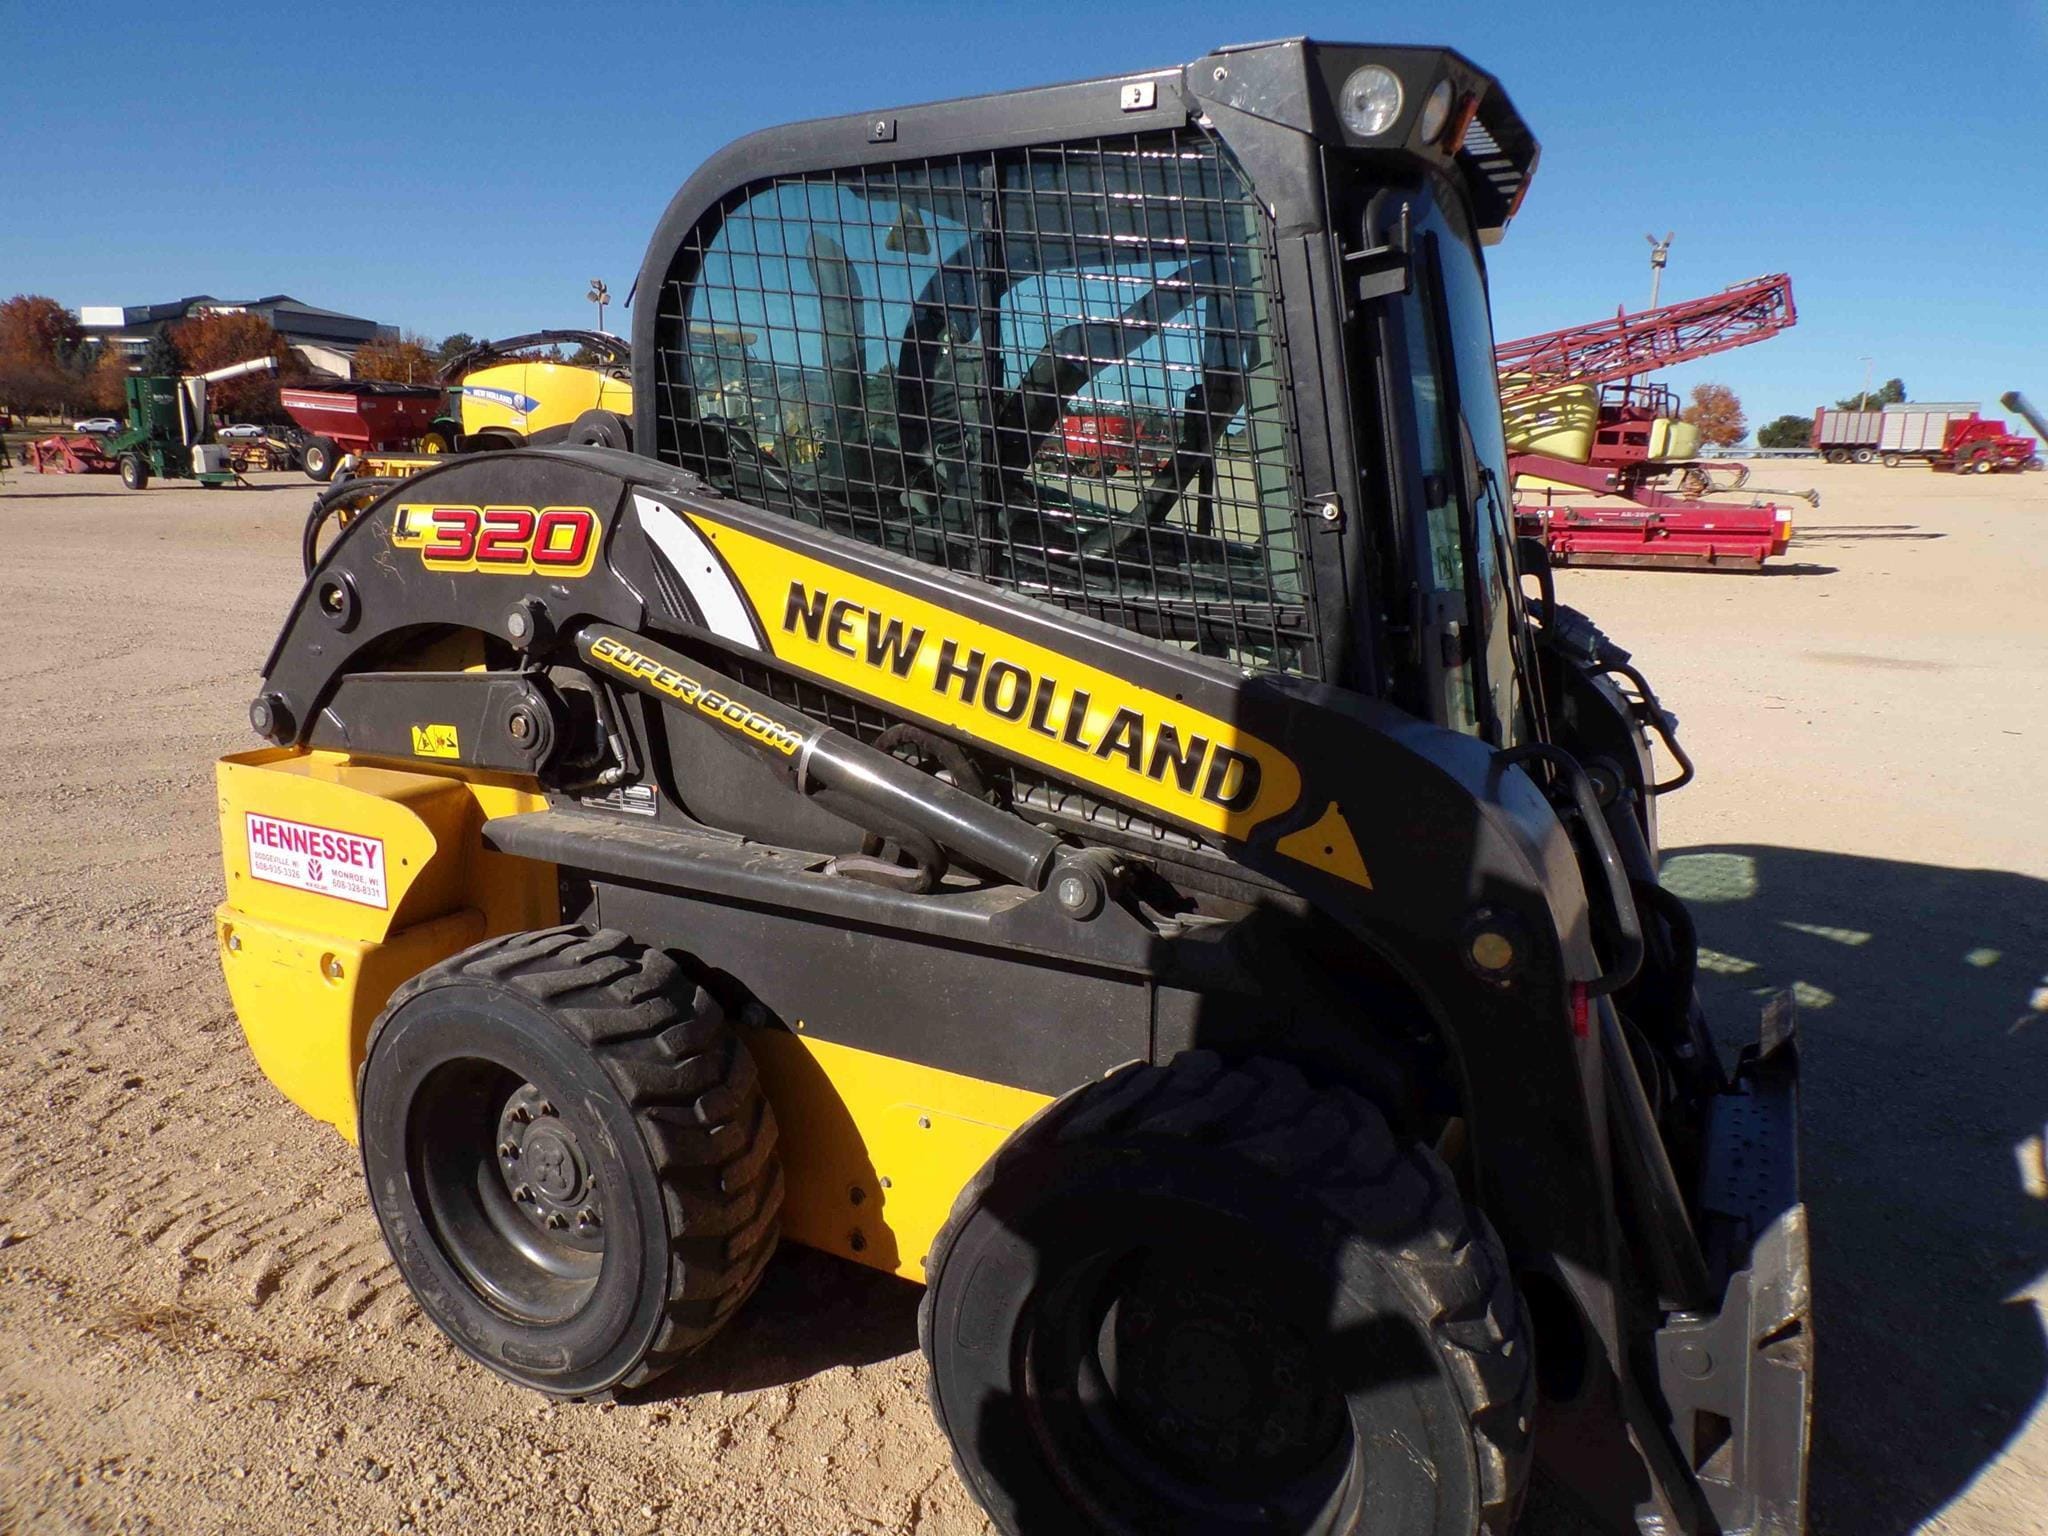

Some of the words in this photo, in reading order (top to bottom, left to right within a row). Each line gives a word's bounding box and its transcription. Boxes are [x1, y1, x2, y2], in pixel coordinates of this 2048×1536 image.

[591, 637, 700, 704] SUPER
[699, 689, 803, 756] BOOM
[782, 580, 926, 679] NEW
[933, 638, 1262, 813] HOLLAND
[251, 819, 377, 869] HENNESSEY
